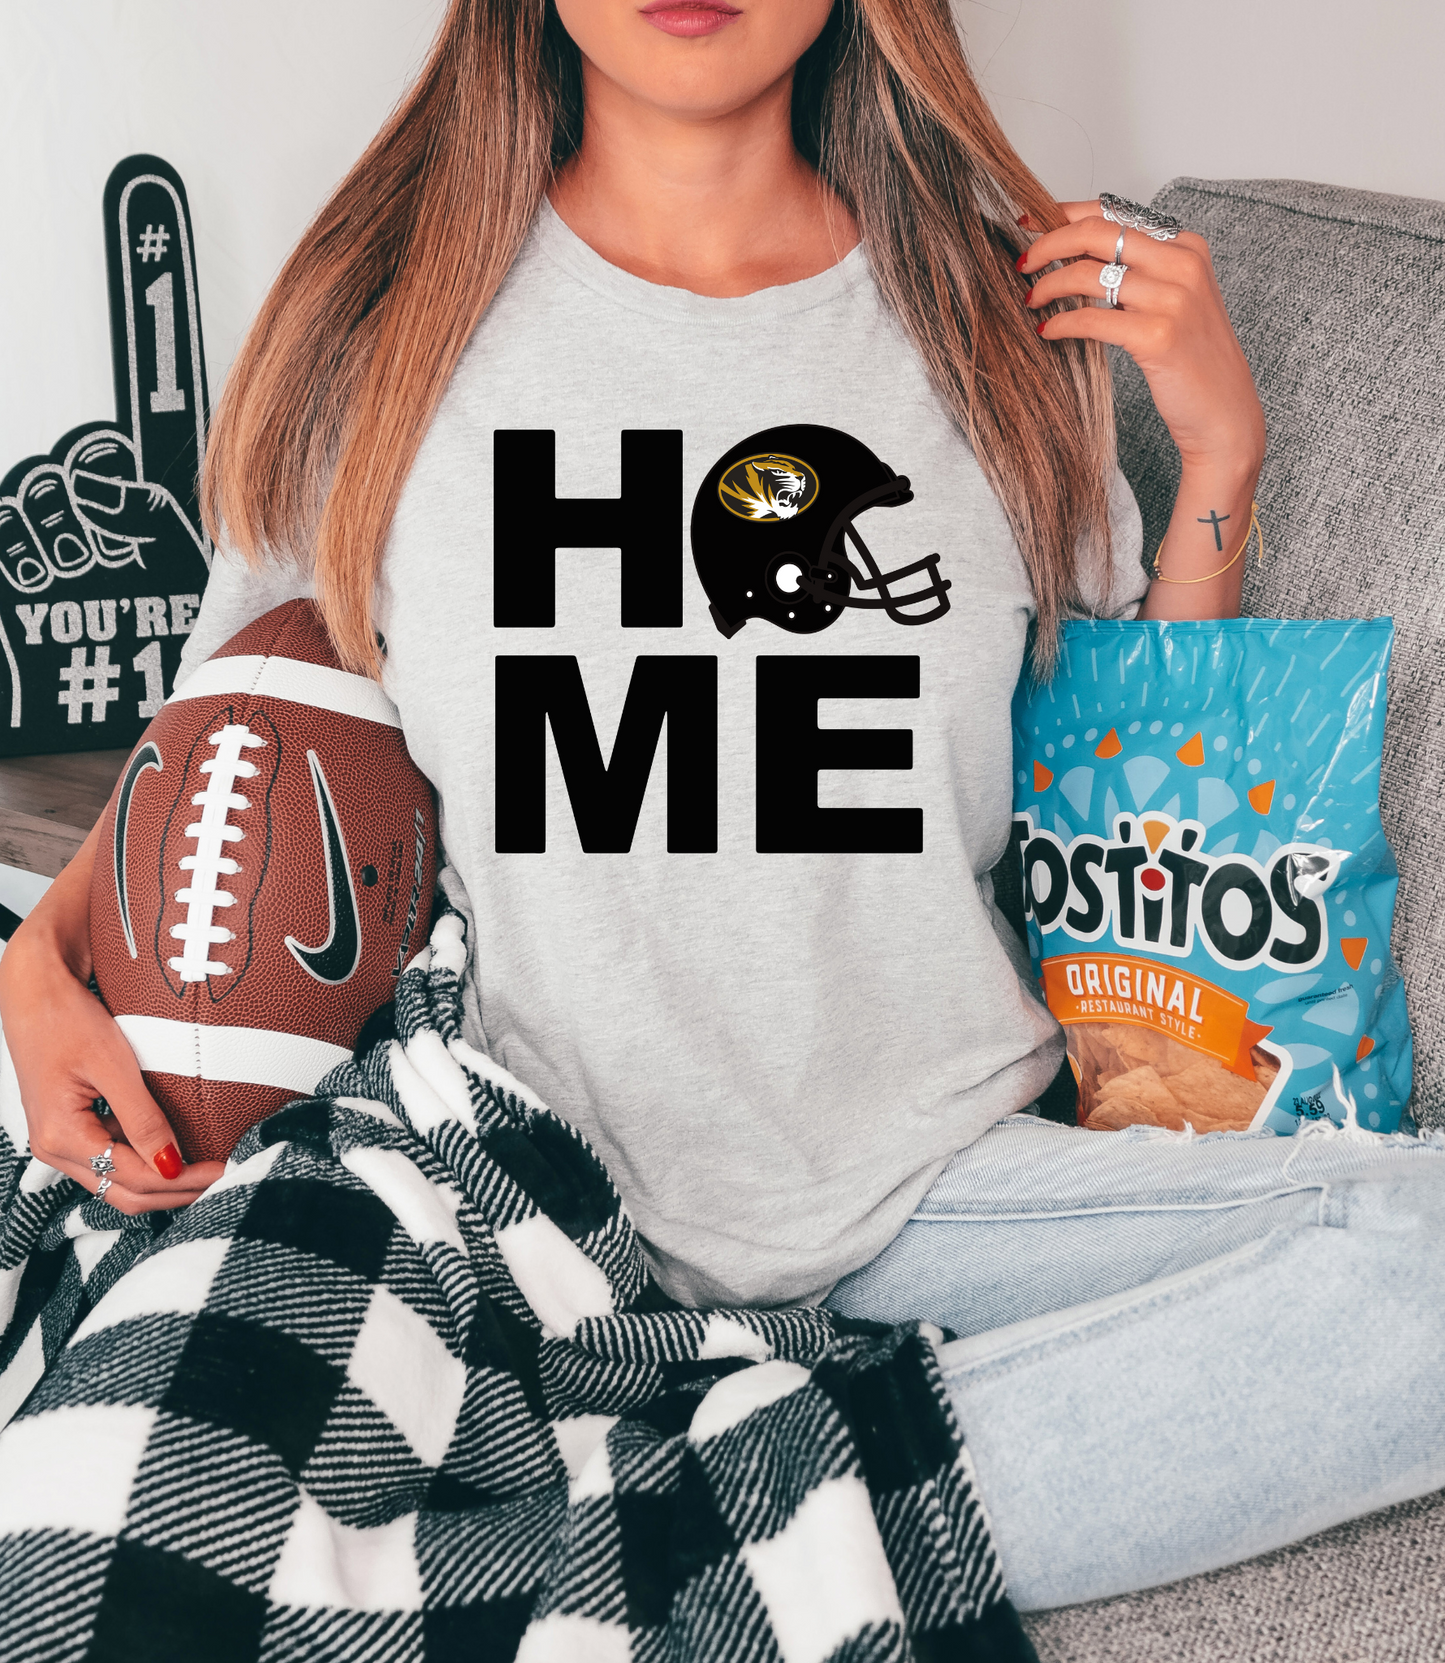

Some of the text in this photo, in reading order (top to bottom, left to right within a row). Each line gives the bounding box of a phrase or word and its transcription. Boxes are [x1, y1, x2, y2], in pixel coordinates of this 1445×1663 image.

[136, 223, 170, 263] #
[145, 271, 186, 413] 1
[15, 594, 200, 645] YOU'RE
[58, 640, 167, 724] #1
[494, 655, 923, 854] ME
[1066, 963, 1203, 1024] ORIGINAL
[1298, 984, 1354, 1003] guaranteed fresh
